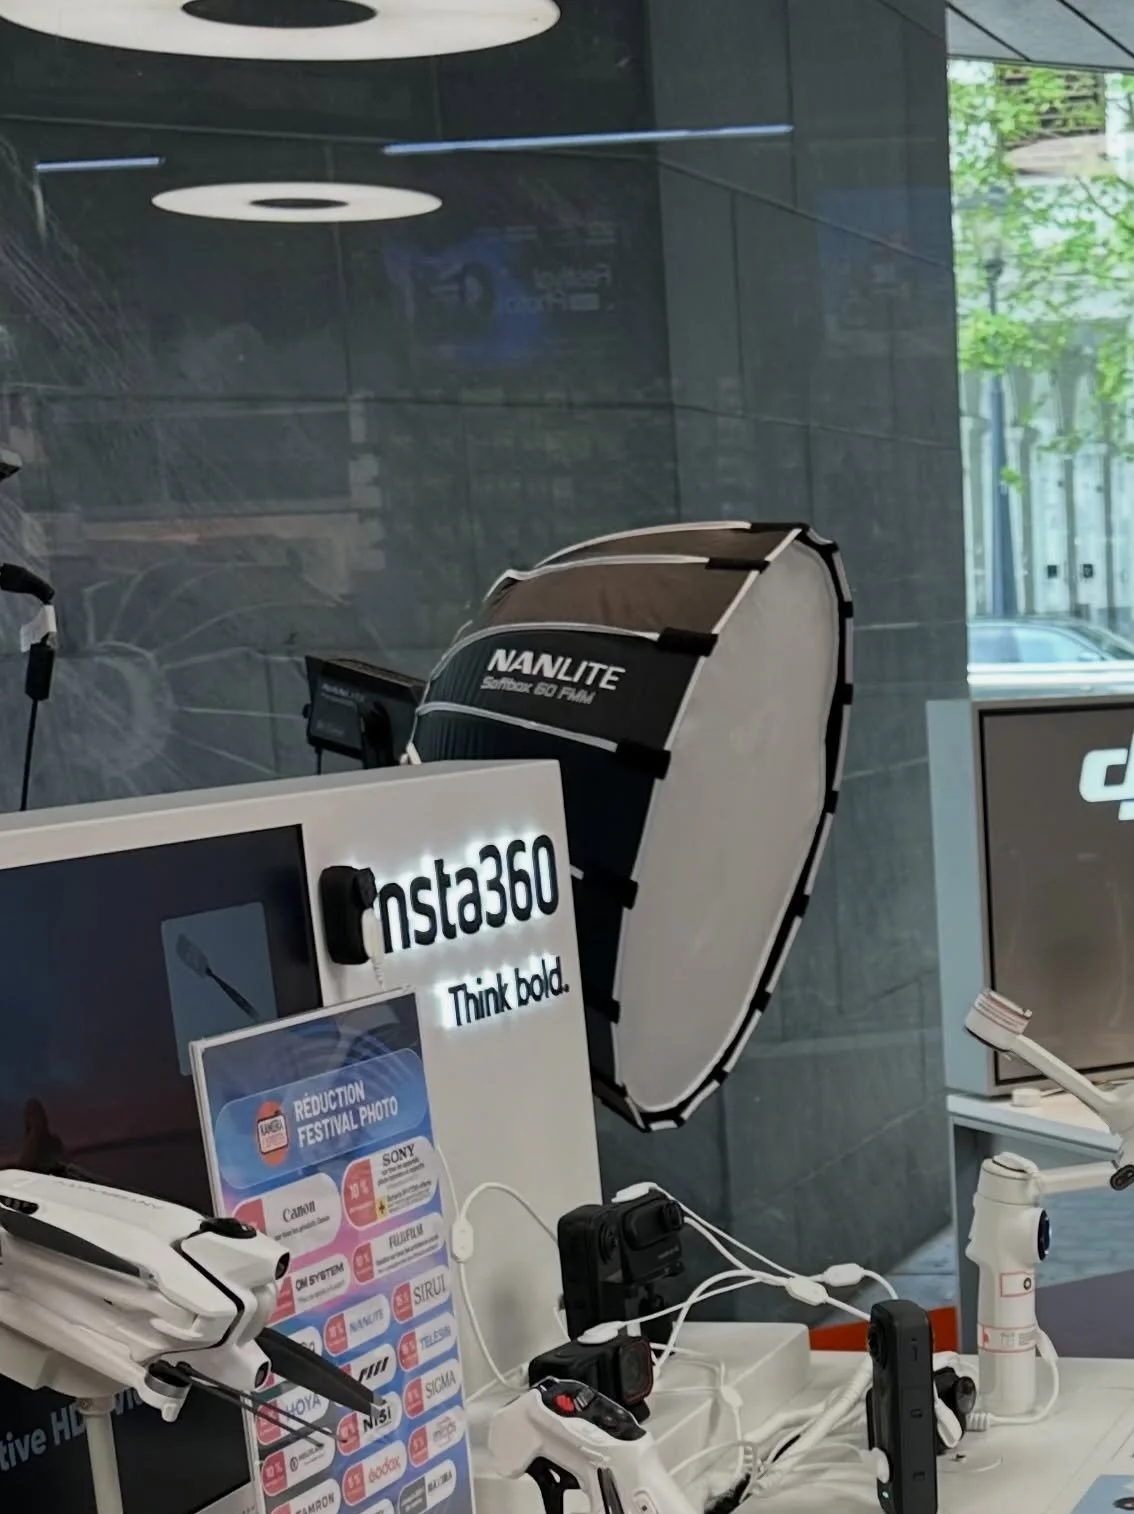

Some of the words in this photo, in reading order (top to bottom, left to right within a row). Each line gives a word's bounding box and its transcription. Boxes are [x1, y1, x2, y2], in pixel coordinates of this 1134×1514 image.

[480, 676, 532, 694] Softbox
[488, 648, 626, 691] NANLITE
[378, 833, 560, 954] nsta360
[448, 972, 509, 1027] Think
[514, 956, 570, 1009] bold.
[294, 1080, 365, 1122] RÉDUCTION
[297, 1113, 358, 1148] FESTIVAL
[359, 1095, 398, 1127] PHOTO
[382, 1143, 415, 1167] SONY
[283, 1200, 316, 1223] Canon
[309, 1262, 344, 1286] SYSTEM
[413, 1273, 446, 1305] SIRUI
[425, 1369, 457, 1399] SIGMA
[0, 1428, 48, 1471] tive
